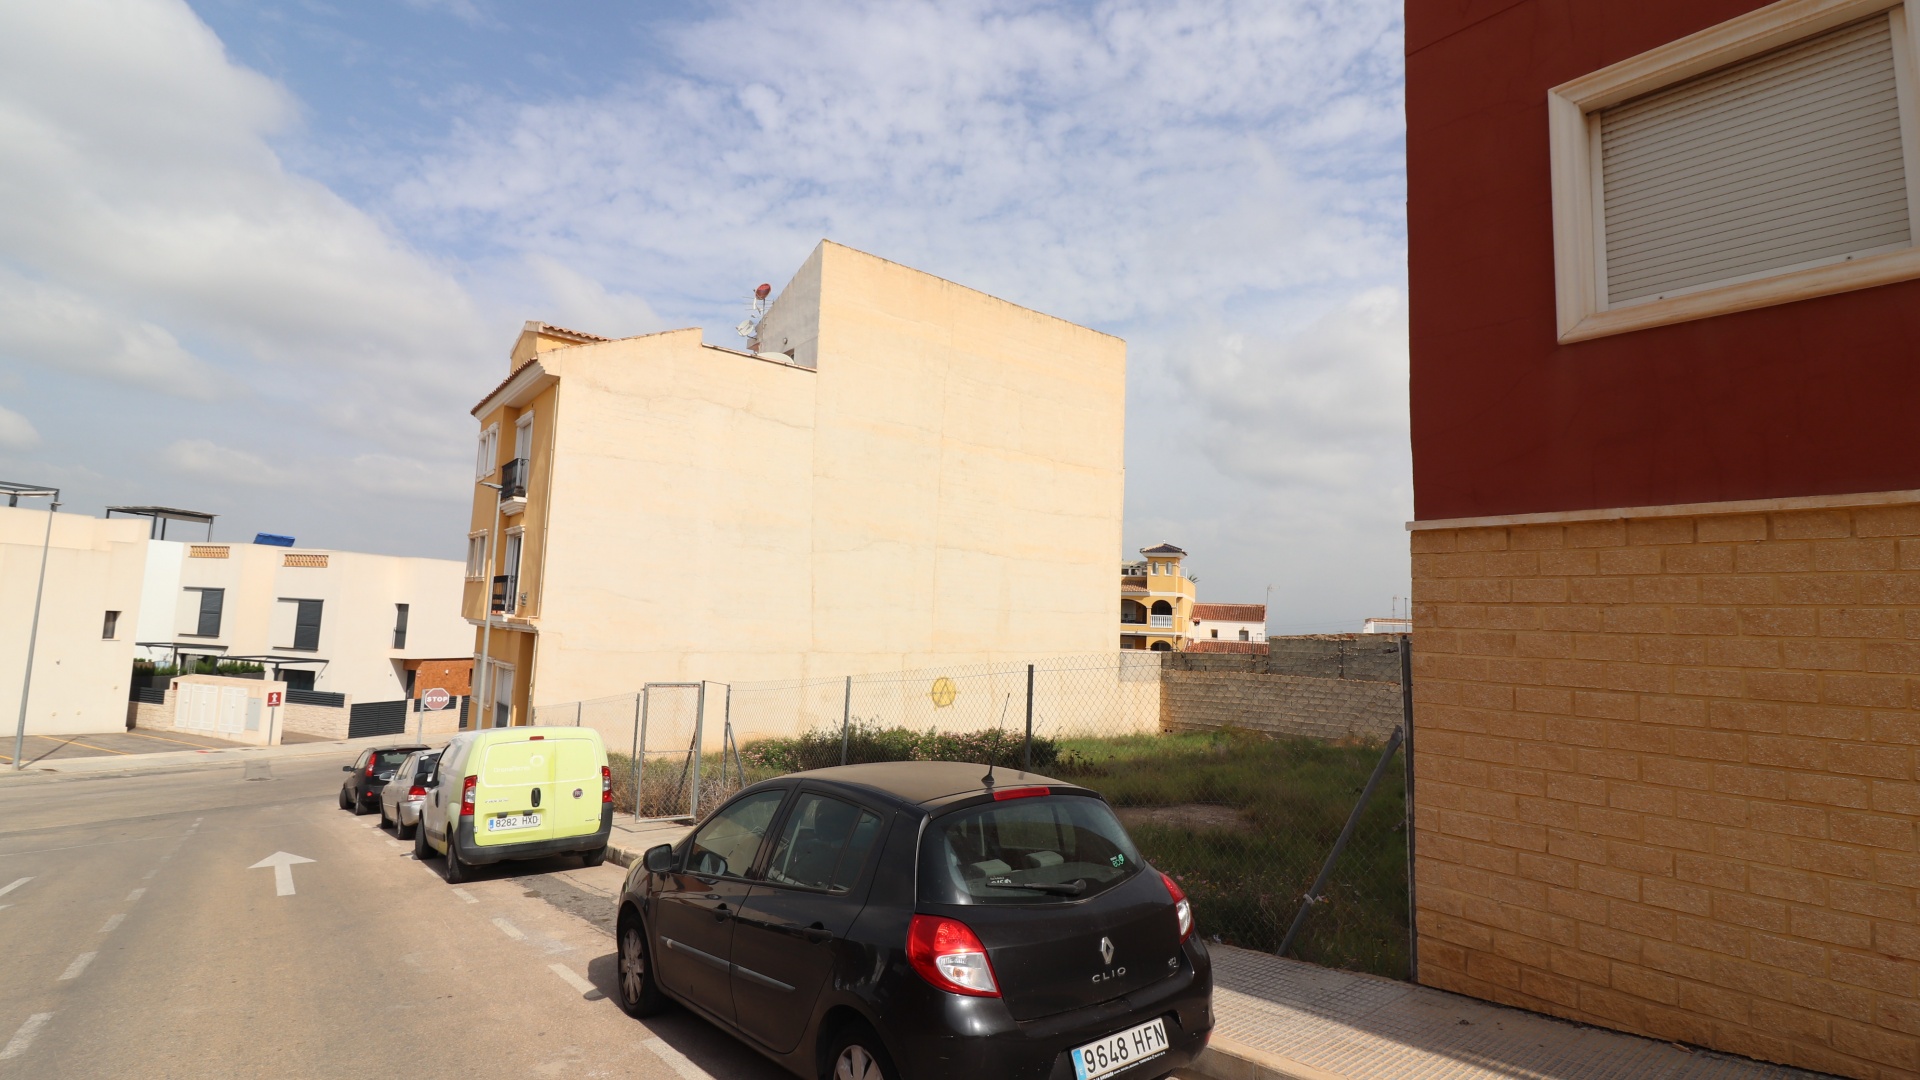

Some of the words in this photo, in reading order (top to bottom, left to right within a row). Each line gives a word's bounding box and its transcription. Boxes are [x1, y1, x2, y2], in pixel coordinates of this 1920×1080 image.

[495, 817, 517, 828] 8282
[522, 815, 538, 825] HXD
[1092, 966, 1126, 983] CLIO
[1084, 1037, 1129, 1074] 9648
[1132, 1022, 1166, 1055] HFN
